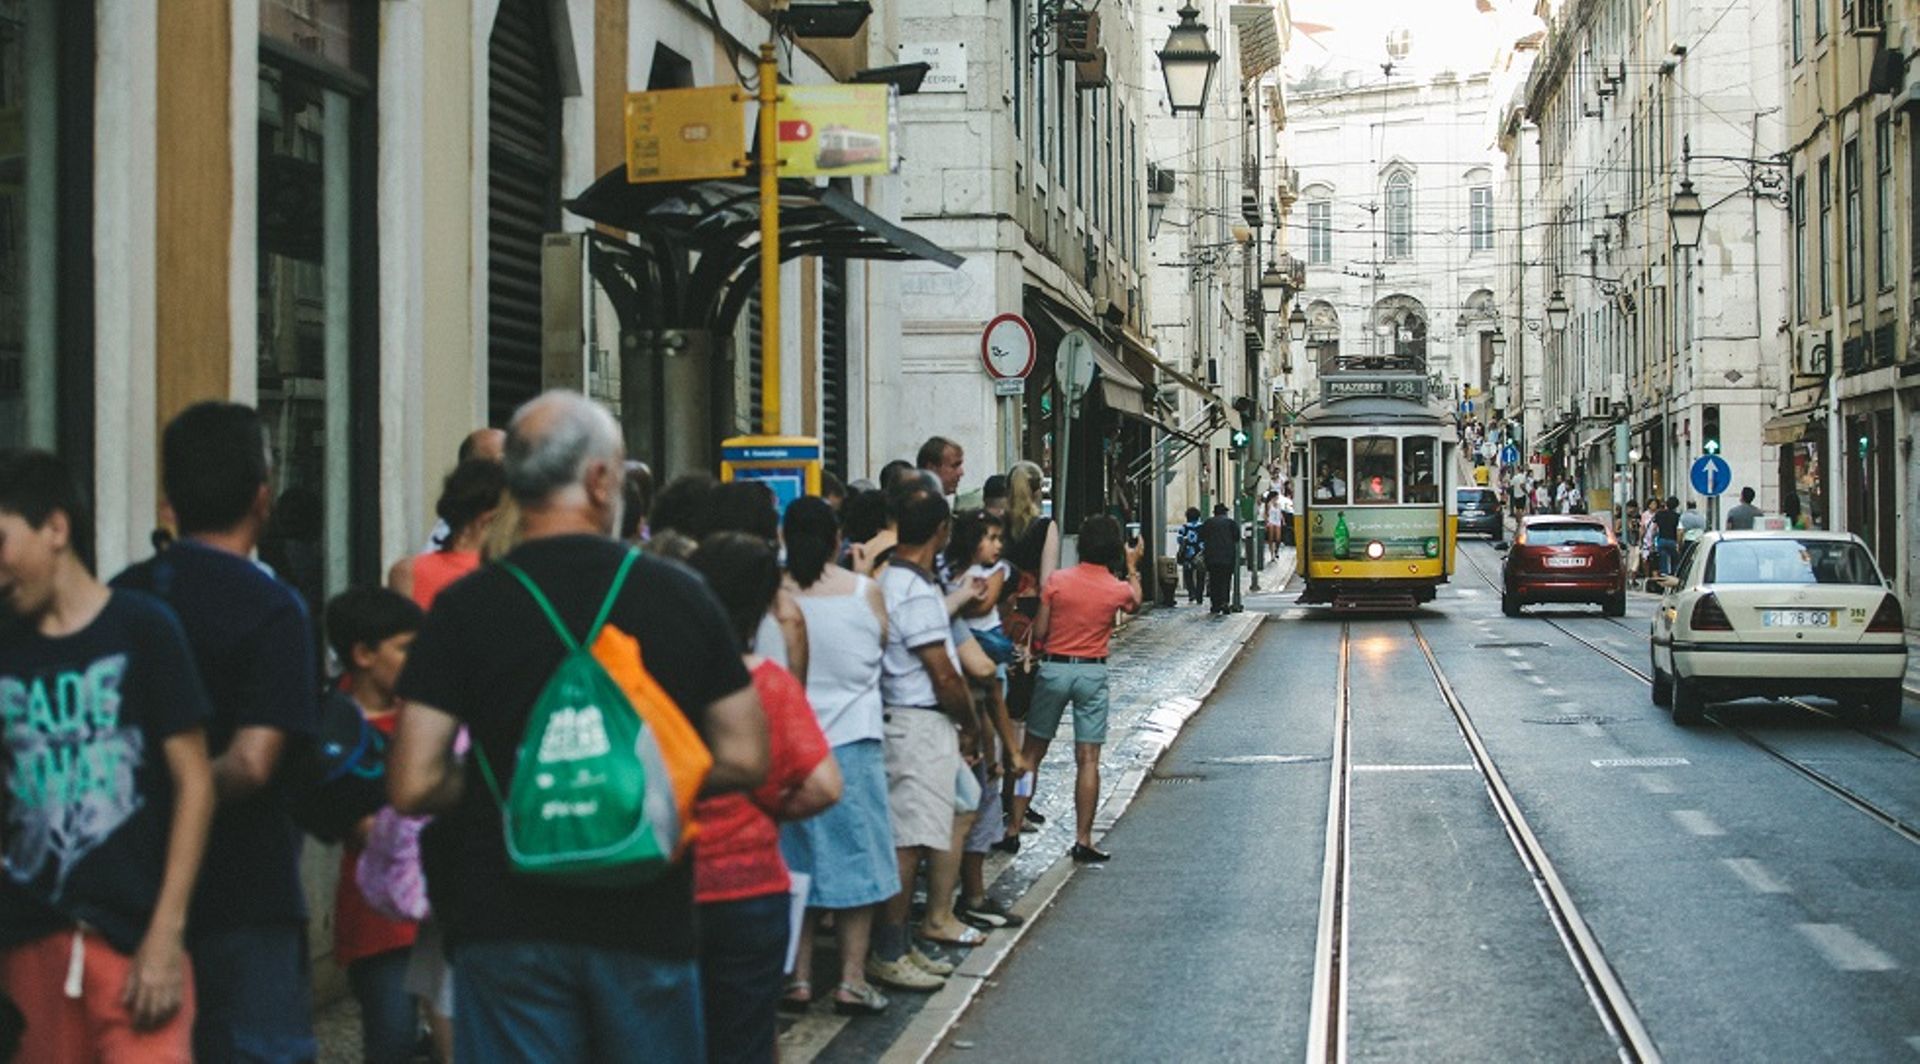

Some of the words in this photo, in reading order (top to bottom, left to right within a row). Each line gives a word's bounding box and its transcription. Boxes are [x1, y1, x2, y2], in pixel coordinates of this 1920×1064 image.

[796, 123, 808, 138] 4
[1331, 382, 1384, 392] PRAZERES
[1395, 381, 1415, 394] 28
